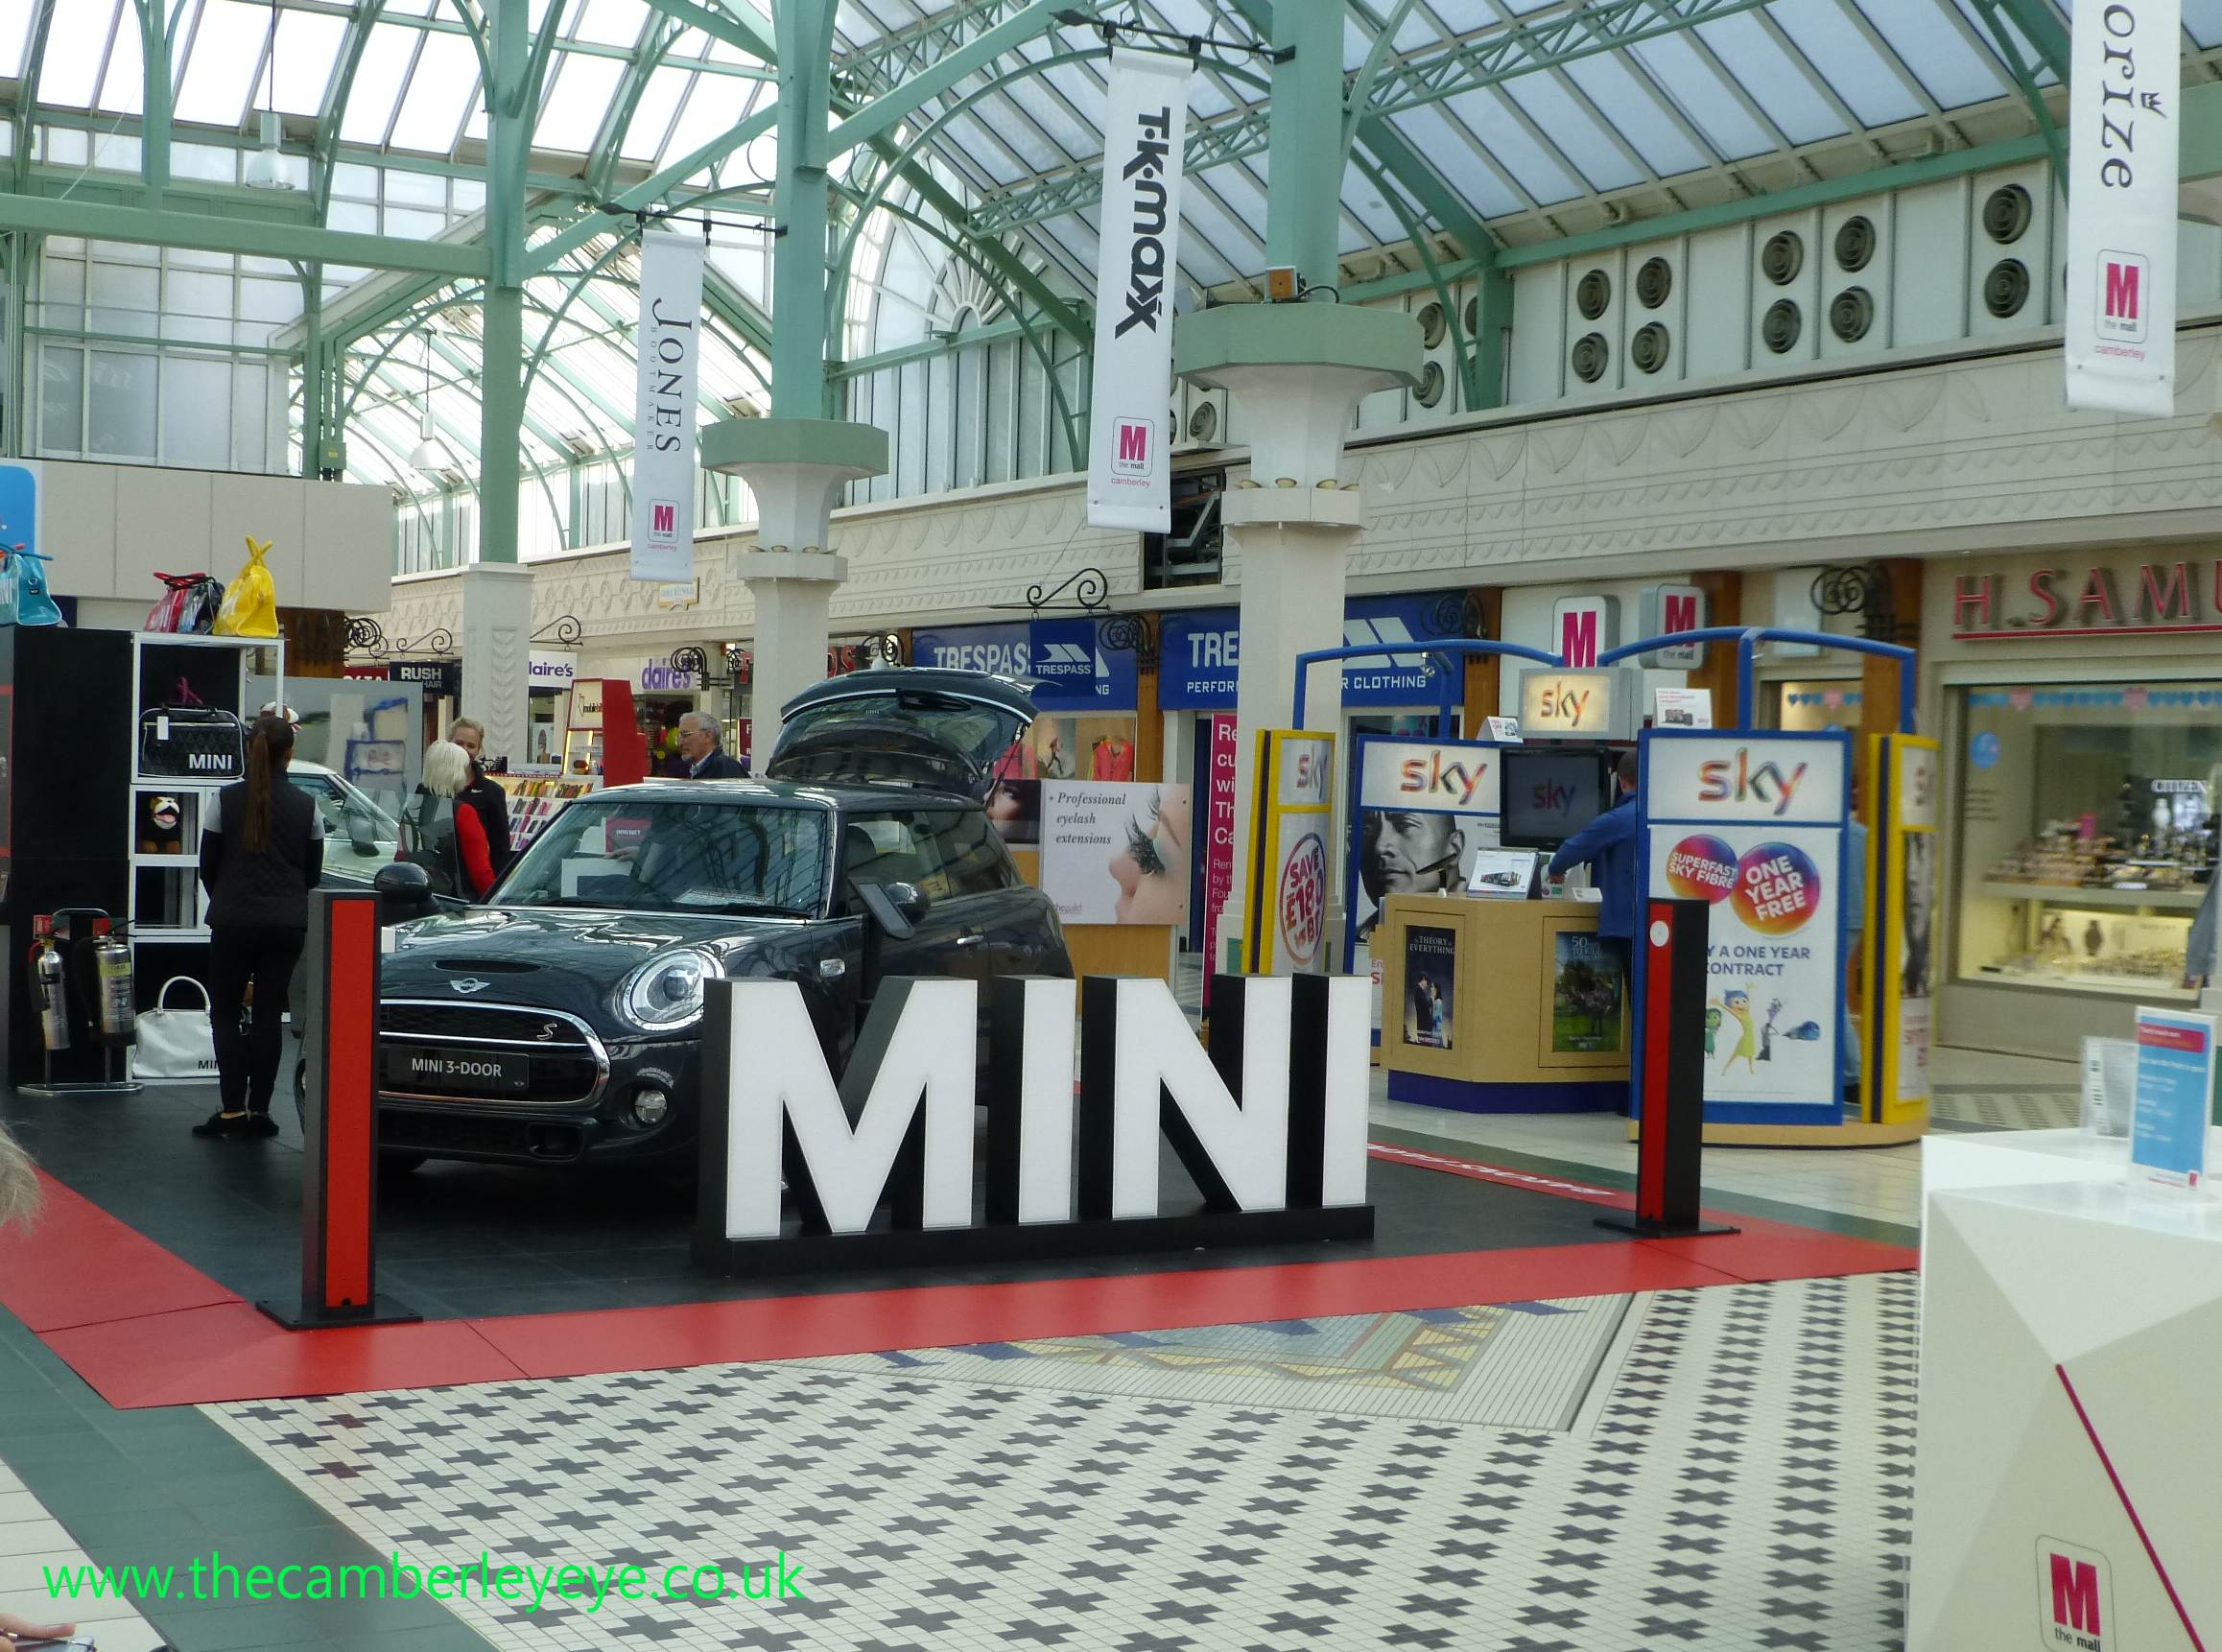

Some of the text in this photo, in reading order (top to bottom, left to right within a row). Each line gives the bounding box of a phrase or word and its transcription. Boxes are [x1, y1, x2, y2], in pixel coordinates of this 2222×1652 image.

[2105, 262, 2139, 319] M
[647, 325, 659, 453] BOOTMAKER
[652, 297, 693, 452] JONES
[1119, 425, 1146, 461] M
[1111, 477, 1151, 488] camberley
[653, 505, 674, 531] M
[1665, 595, 1696, 648] M
[1187, 630, 1239, 669] TRE
[1562, 611, 1597, 669] M
[401, 667, 442, 680] RUSH
[529, 660, 574, 677] laire's
[934, 643, 1030, 676] TRESPAS
[1035, 664, 1092, 675] TRESPASS
[1354, 674, 1427, 691] CLOTHING
[1541, 681, 1590, 727] sky
[188, 753, 233, 770] MINI
[1400, 749, 1487, 806] sky
[1697, 747, 1808, 815] sky
[2151, 779, 2207, 793] CITIZEN
[1057, 791, 1127, 808] Professional
[1531, 778, 1576, 814] sky
[1056, 813, 1097, 827] eyelash
[1056, 834, 1112, 846] extensions
[1289, 844, 1320, 888] SAVE
[1668, 862, 1735, 889] SKY FIBRE
[1671, 852, 1737, 878] SUPERFAST
[1745, 854, 1793, 885] ONE
[1745, 872, 1805, 906] YEAR
[1755, 890, 1807, 922] FREE
[1420, 935, 1447, 946] THEORY
[1719, 945, 1731, 957] A
[1734, 945, 1766, 959] ONE
[1770, 946, 1810, 960] YEAR
[198, 1059, 220, 1070] MI
[412, 1058, 502, 1077] MINI 3-DOOR
[724, 976, 1374, 1240] MINI
[2049, 1552, 2101, 1637] M
[2054, 1626, 2101, 1652] the mall
